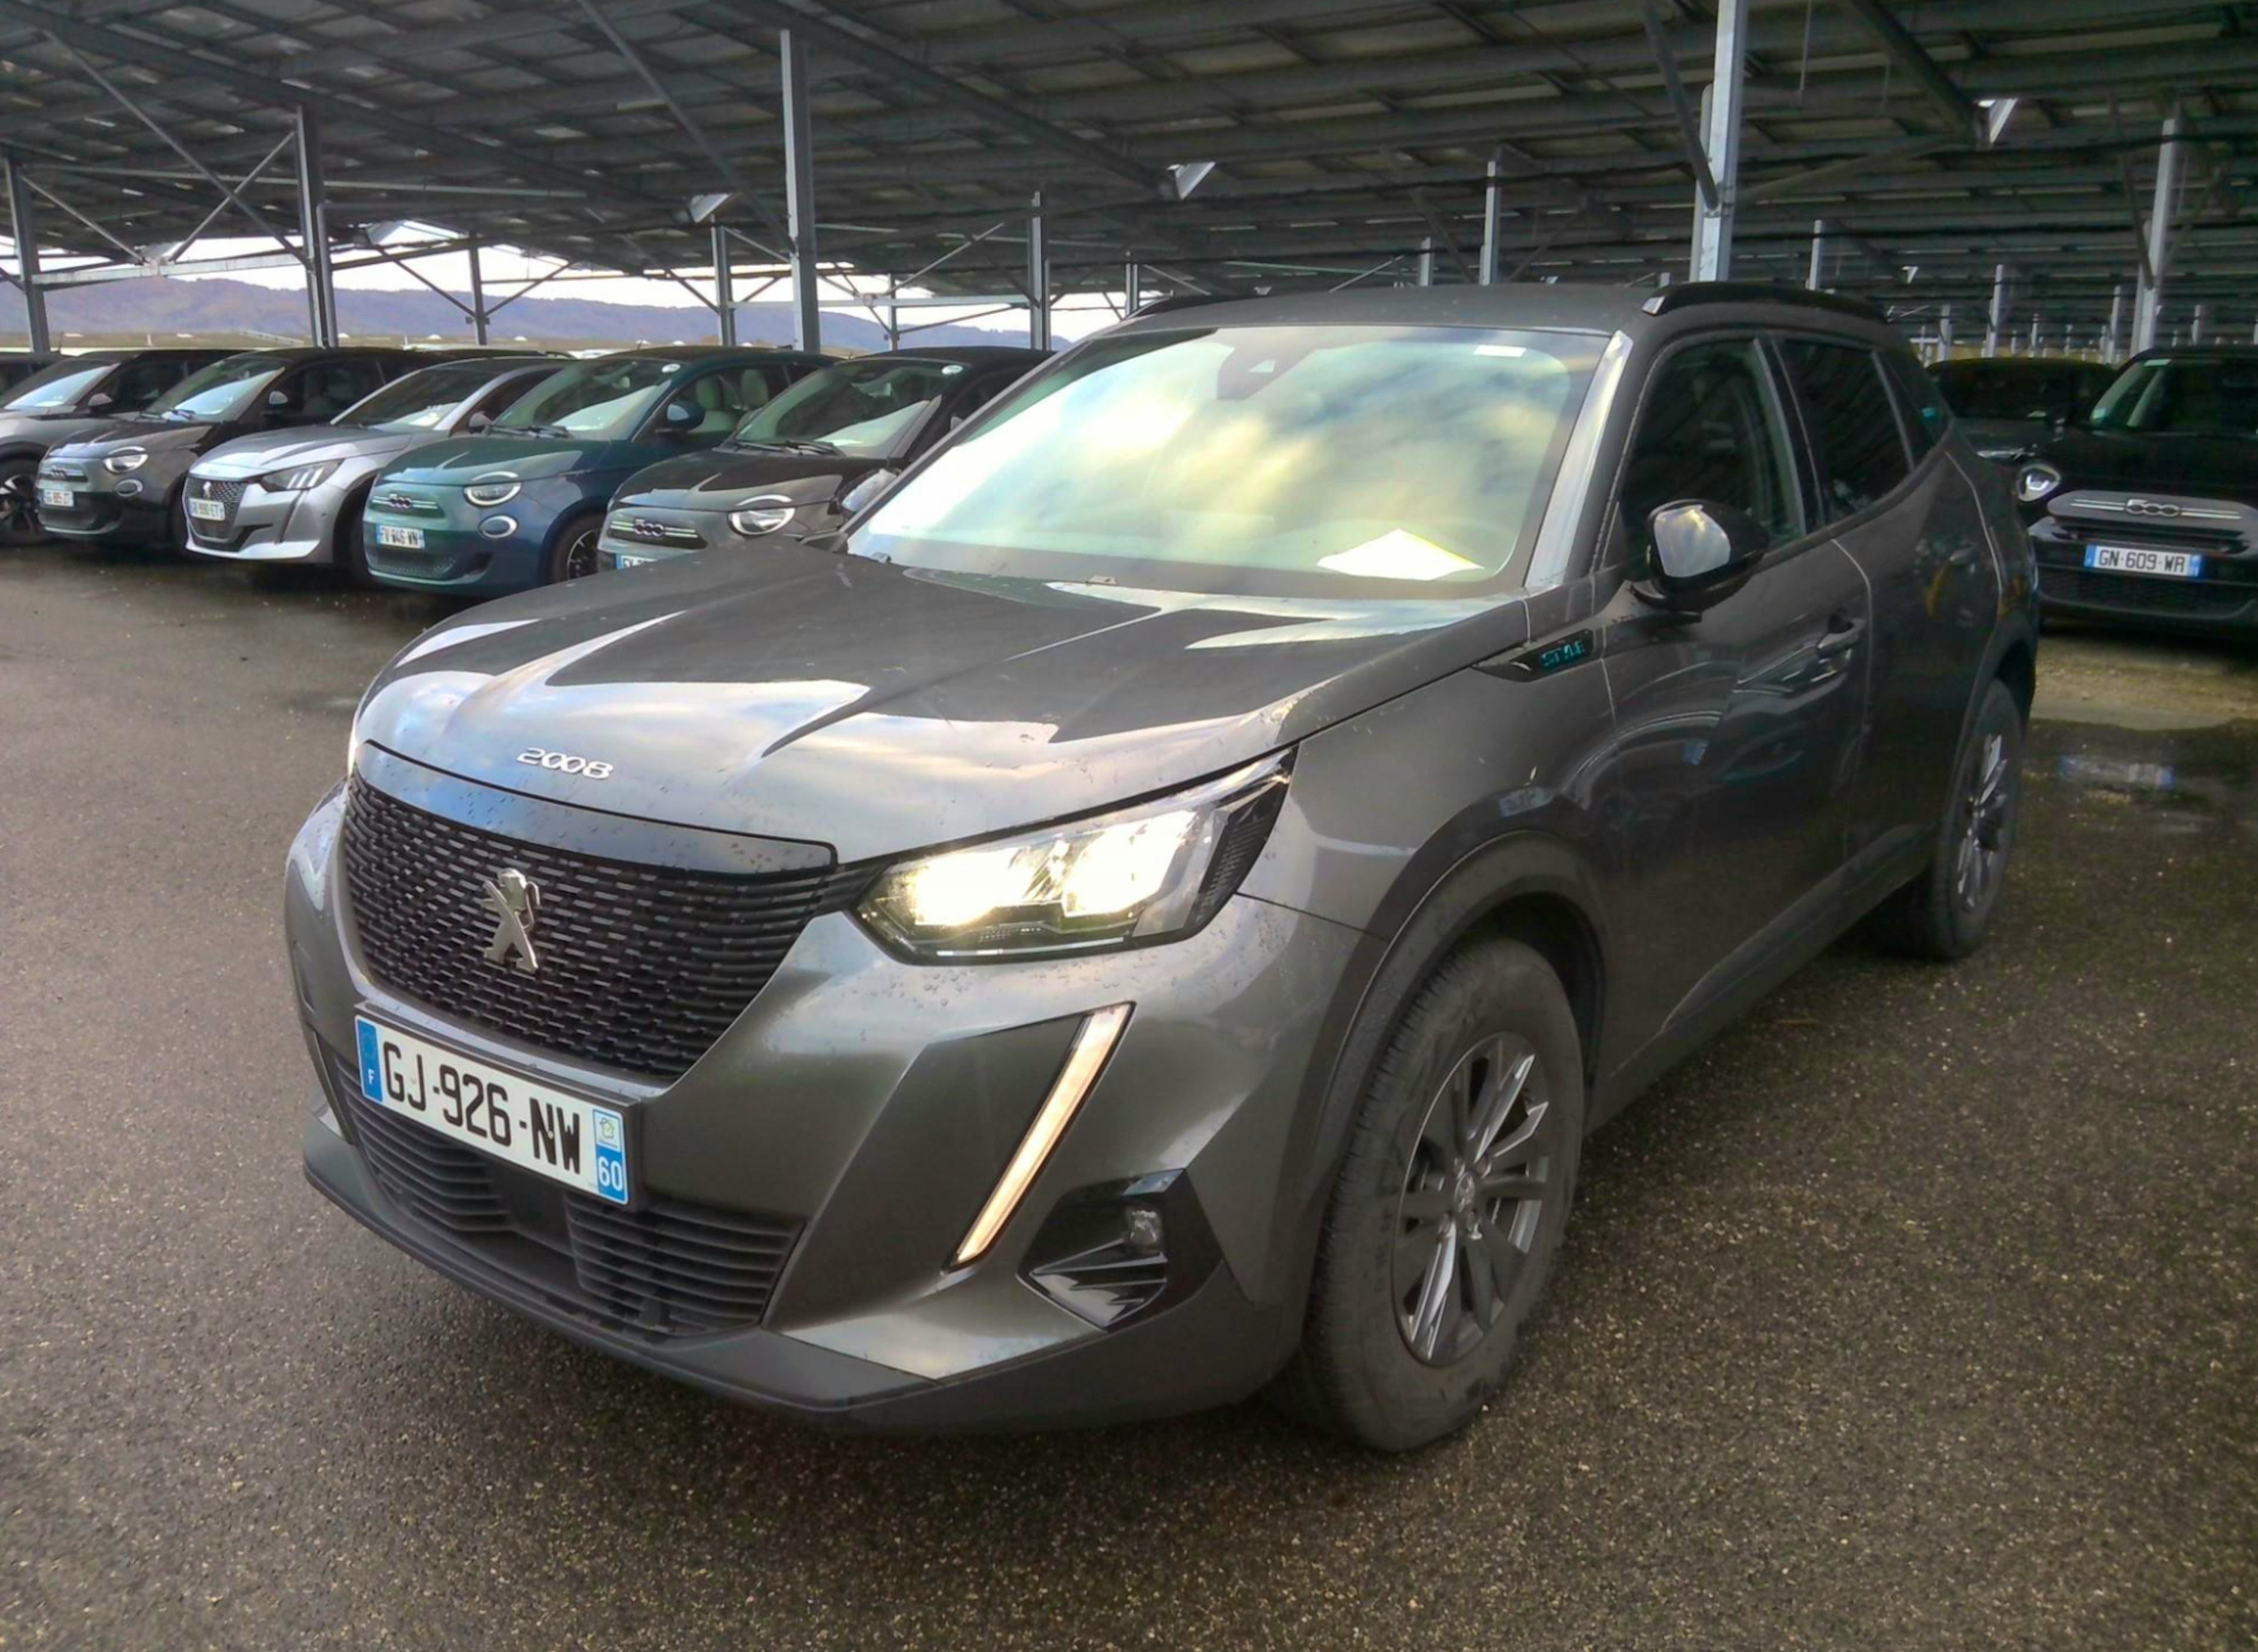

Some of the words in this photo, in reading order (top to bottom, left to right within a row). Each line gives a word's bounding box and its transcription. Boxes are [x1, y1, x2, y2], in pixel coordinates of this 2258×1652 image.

[2126, 499, 2179, 517] 500
[635, 519, 664, 536] 500
[2099, 550, 2185, 573] GN-609-WR
[516, 747, 613, 779] 2008
[368, 1068, 373, 1085] F
[383, 1042, 579, 1175] GJ-926-NW
[599, 1159, 623, 1192] 60
